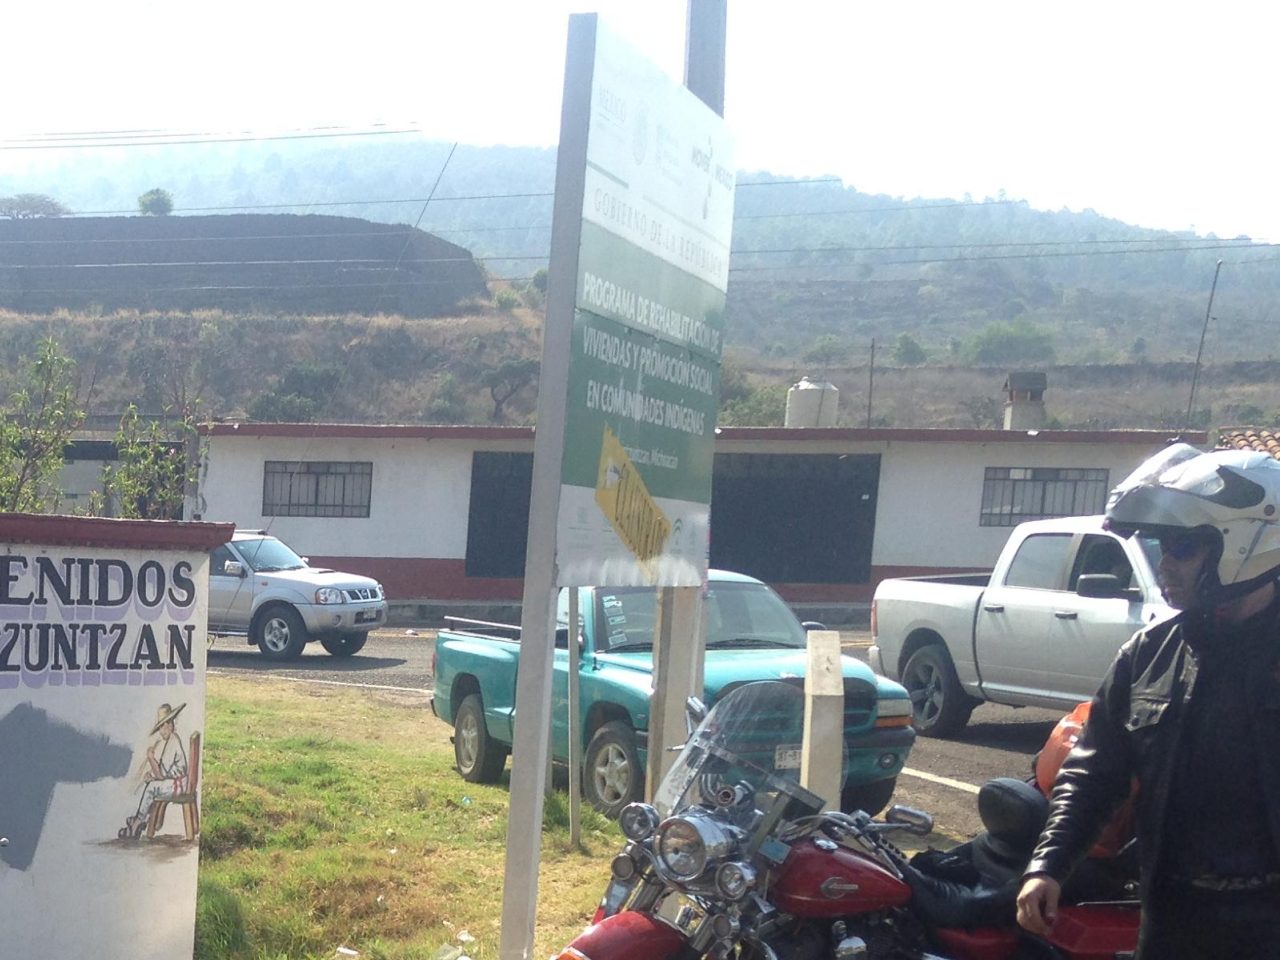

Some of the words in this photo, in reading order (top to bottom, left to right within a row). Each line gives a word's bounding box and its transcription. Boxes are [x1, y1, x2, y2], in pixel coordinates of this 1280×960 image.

[594, 187, 647, 236] GOBIERNO
[583, 271, 636, 321] PROGRAMA
[637, 294, 650, 325] DE
[583, 325, 632, 368] VIVIENDAS
[632, 343, 640, 370] Y
[640, 346, 690, 387] PROMOCIÓN
[690, 363, 713, 395] SOCIAL
[586, 379, 601, 409] EN
[601, 383, 664, 426] COMUNIDADES
[664, 398, 705, 436] INDÍGENAS
